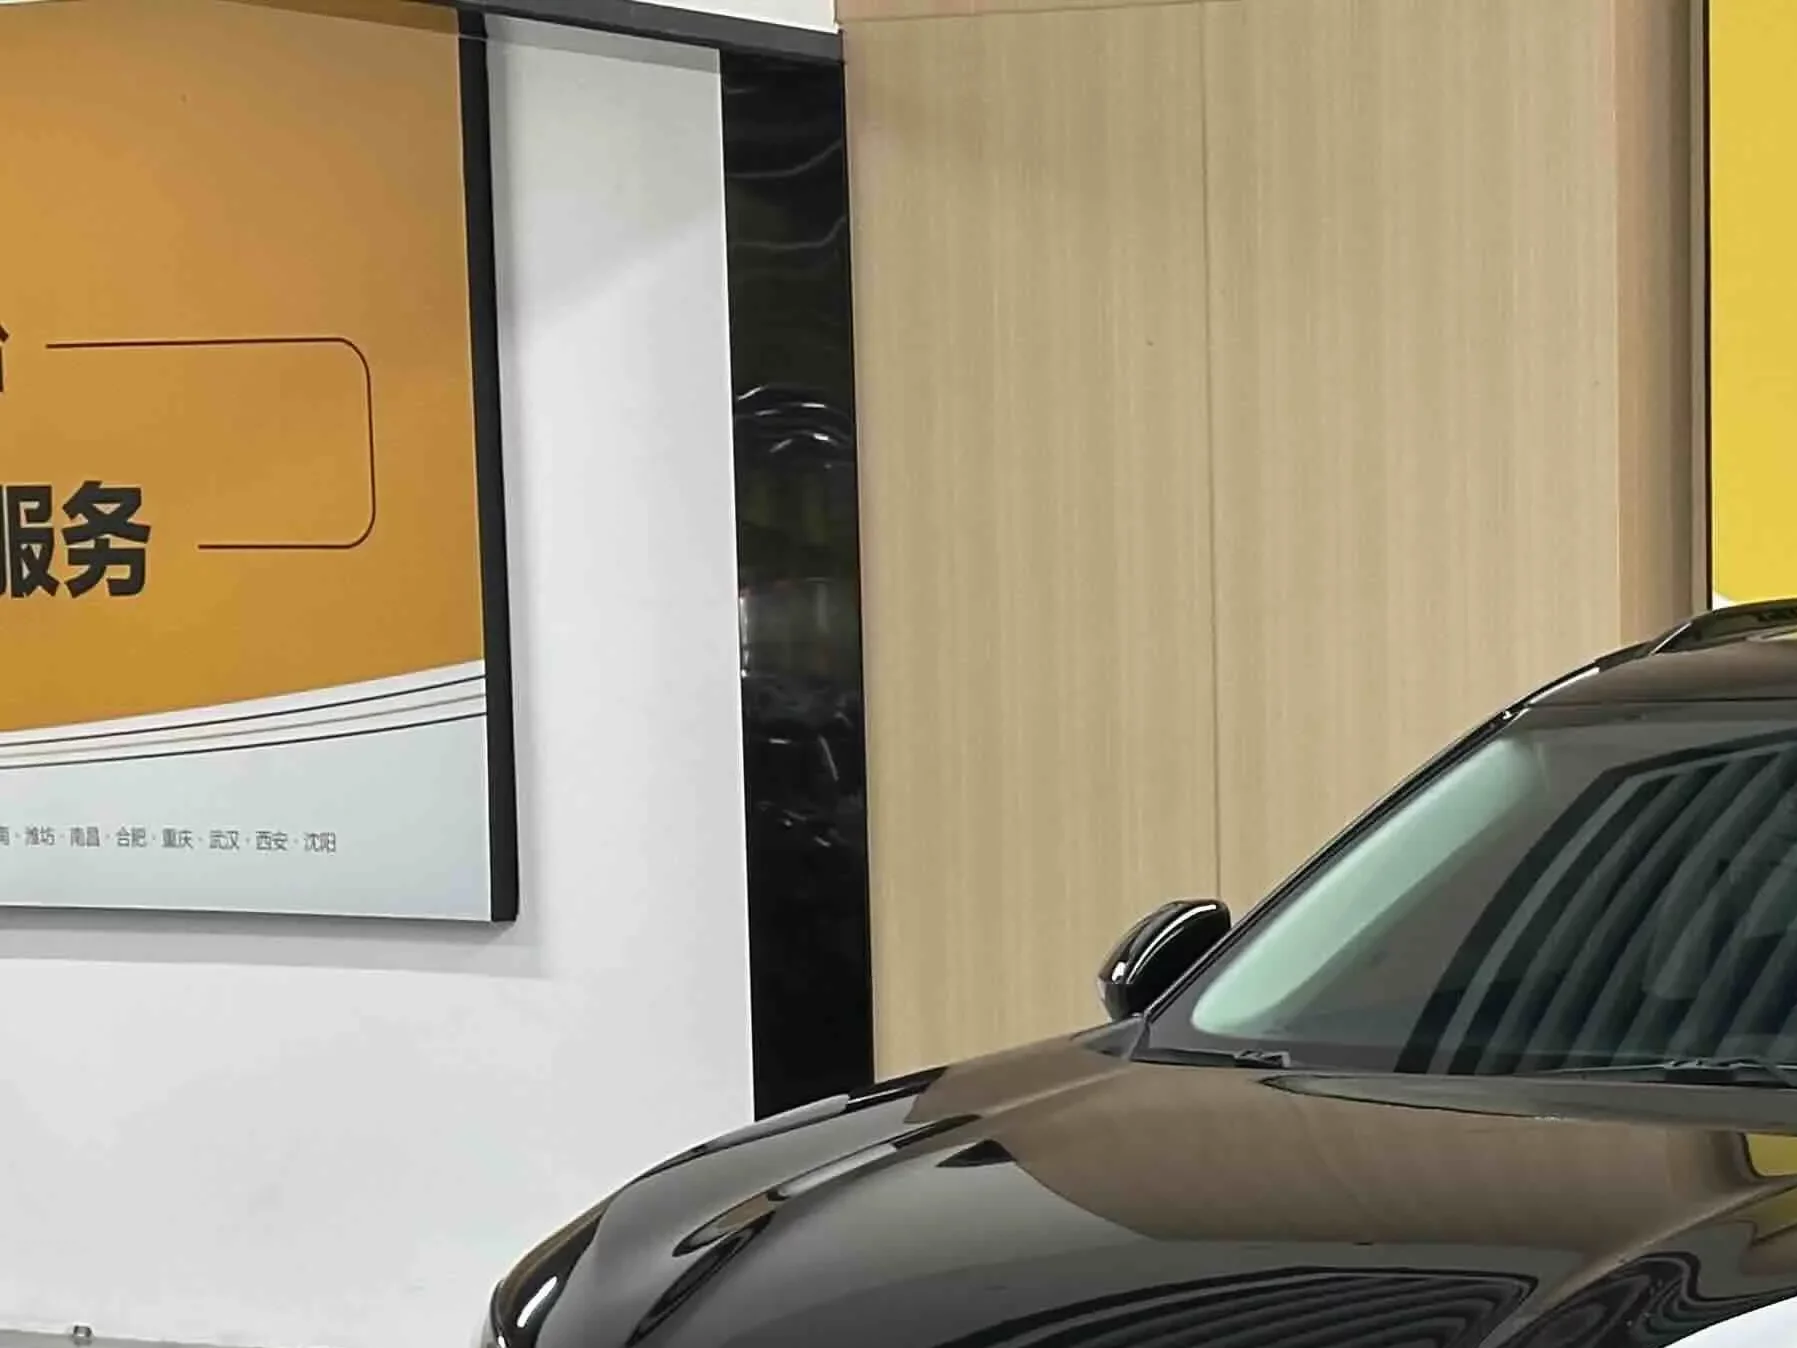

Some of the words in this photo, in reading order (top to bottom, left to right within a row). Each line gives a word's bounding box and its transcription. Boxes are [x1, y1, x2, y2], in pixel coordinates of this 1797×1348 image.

[0, 480, 152, 598] 服务
[24, 826, 55, 846] 潍坊
[70, 826, 100, 848] 南昌
[116, 827, 147, 848] 合肥
[162, 828, 194, 850] 重庆
[209, 830, 240, 851] 武汉
[255, 830, 289, 852] 西安
[303, 832, 336, 854] 沈阳
